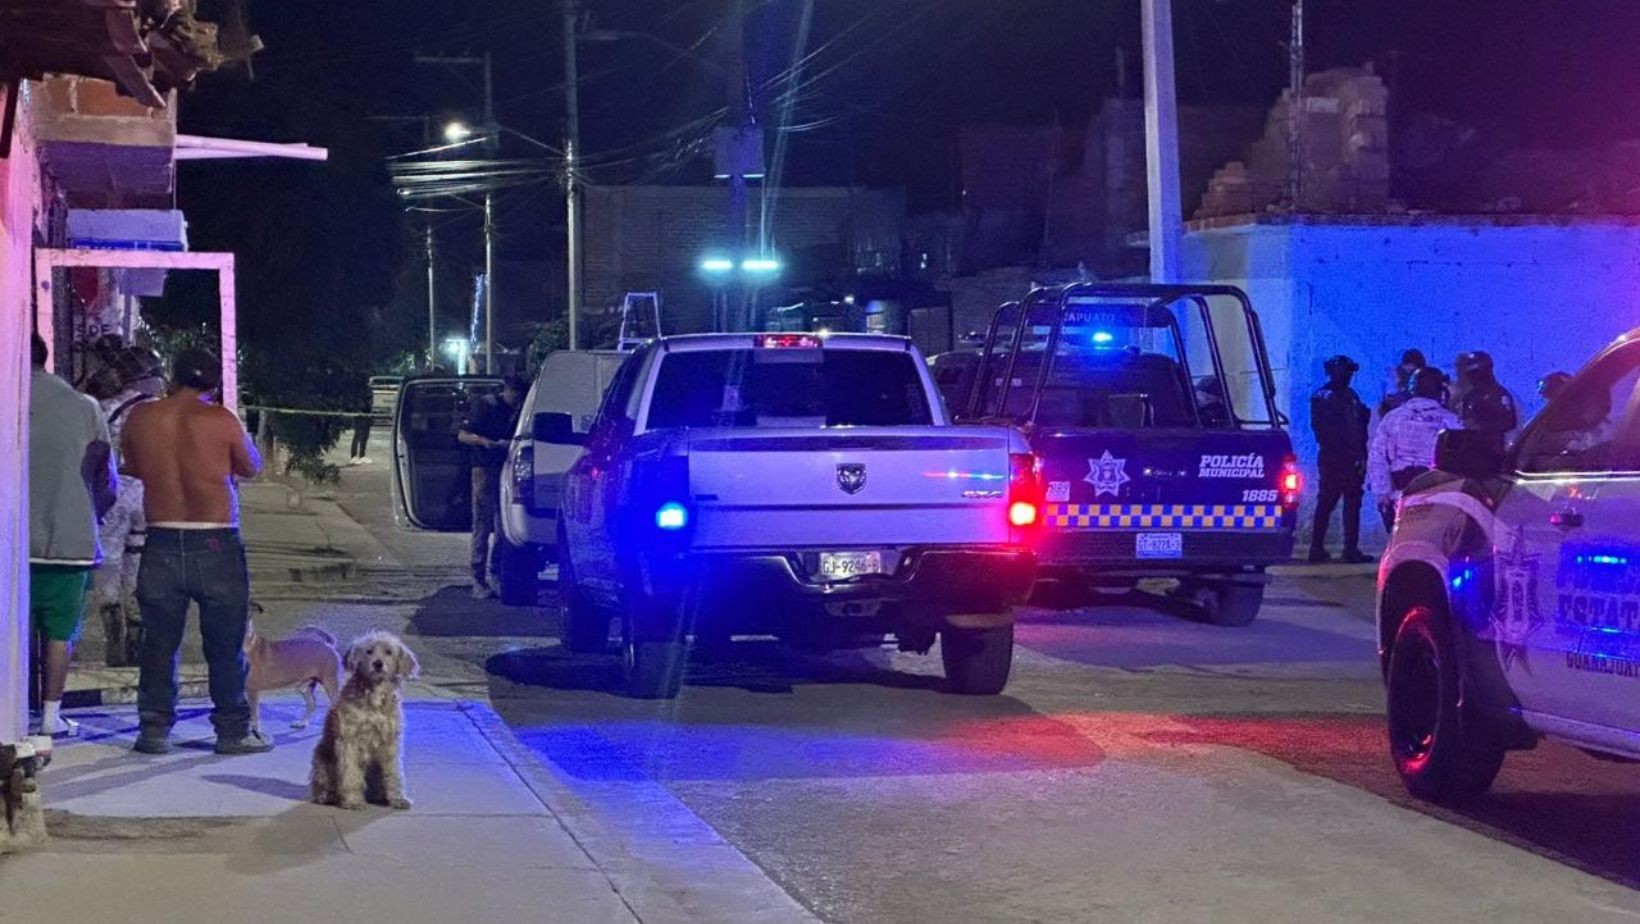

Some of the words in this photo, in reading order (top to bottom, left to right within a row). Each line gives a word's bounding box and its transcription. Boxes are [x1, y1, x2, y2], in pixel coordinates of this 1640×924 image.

[1199, 453, 1264, 468] POLICÍA
[1198, 468, 1264, 478] MUNICIPAL
[1241, 489, 1278, 502] 1885
[1556, 593, 1640, 628] ESTAT
